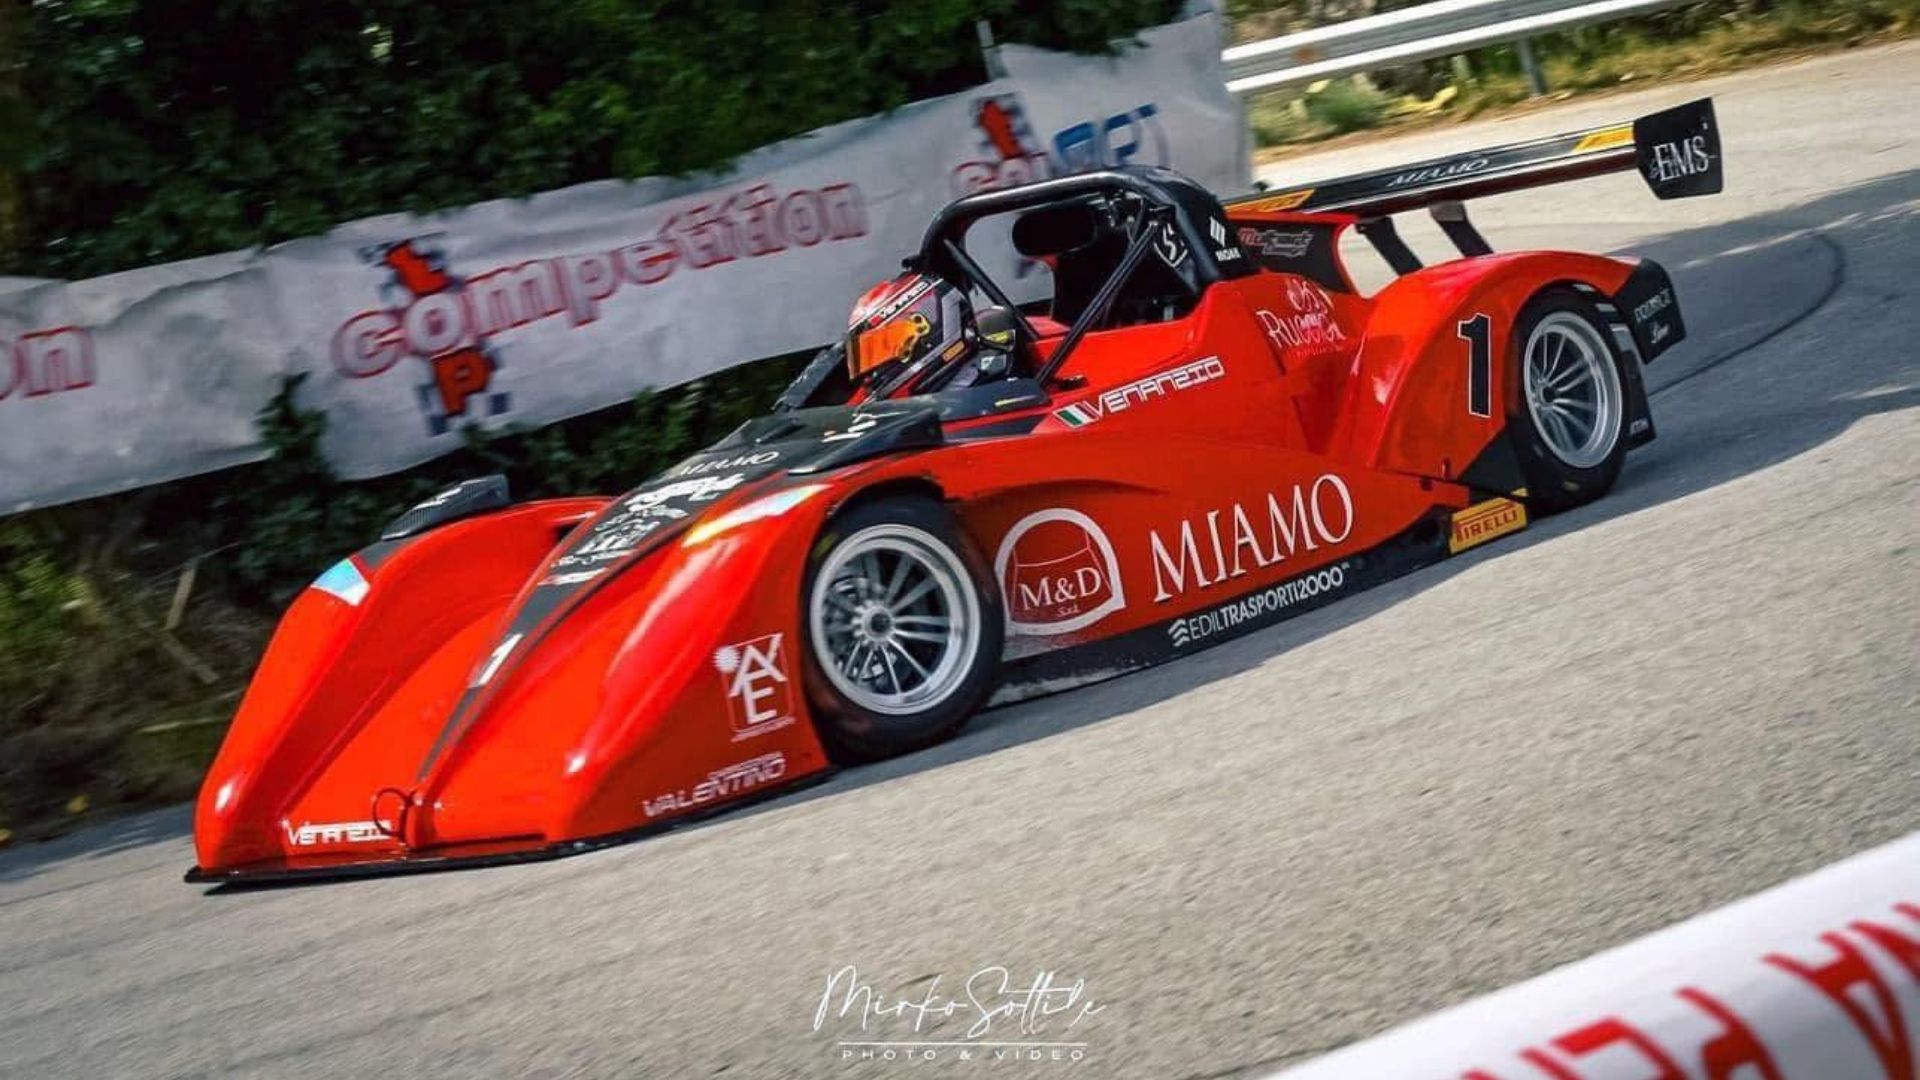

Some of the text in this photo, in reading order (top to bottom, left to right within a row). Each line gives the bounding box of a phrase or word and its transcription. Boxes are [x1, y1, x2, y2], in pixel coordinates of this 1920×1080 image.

[331, 181, 869, 379] competition
[1457, 312, 1493, 418] 1
[1150, 473, 1354, 602] MIAMO
[1455, 502, 1519, 544] PIRELLI
[1018, 567, 1102, 610] M&D
[1188, 565, 1344, 641] EDILTRASPORTI2000
[642, 756, 786, 817] VALENTINO
